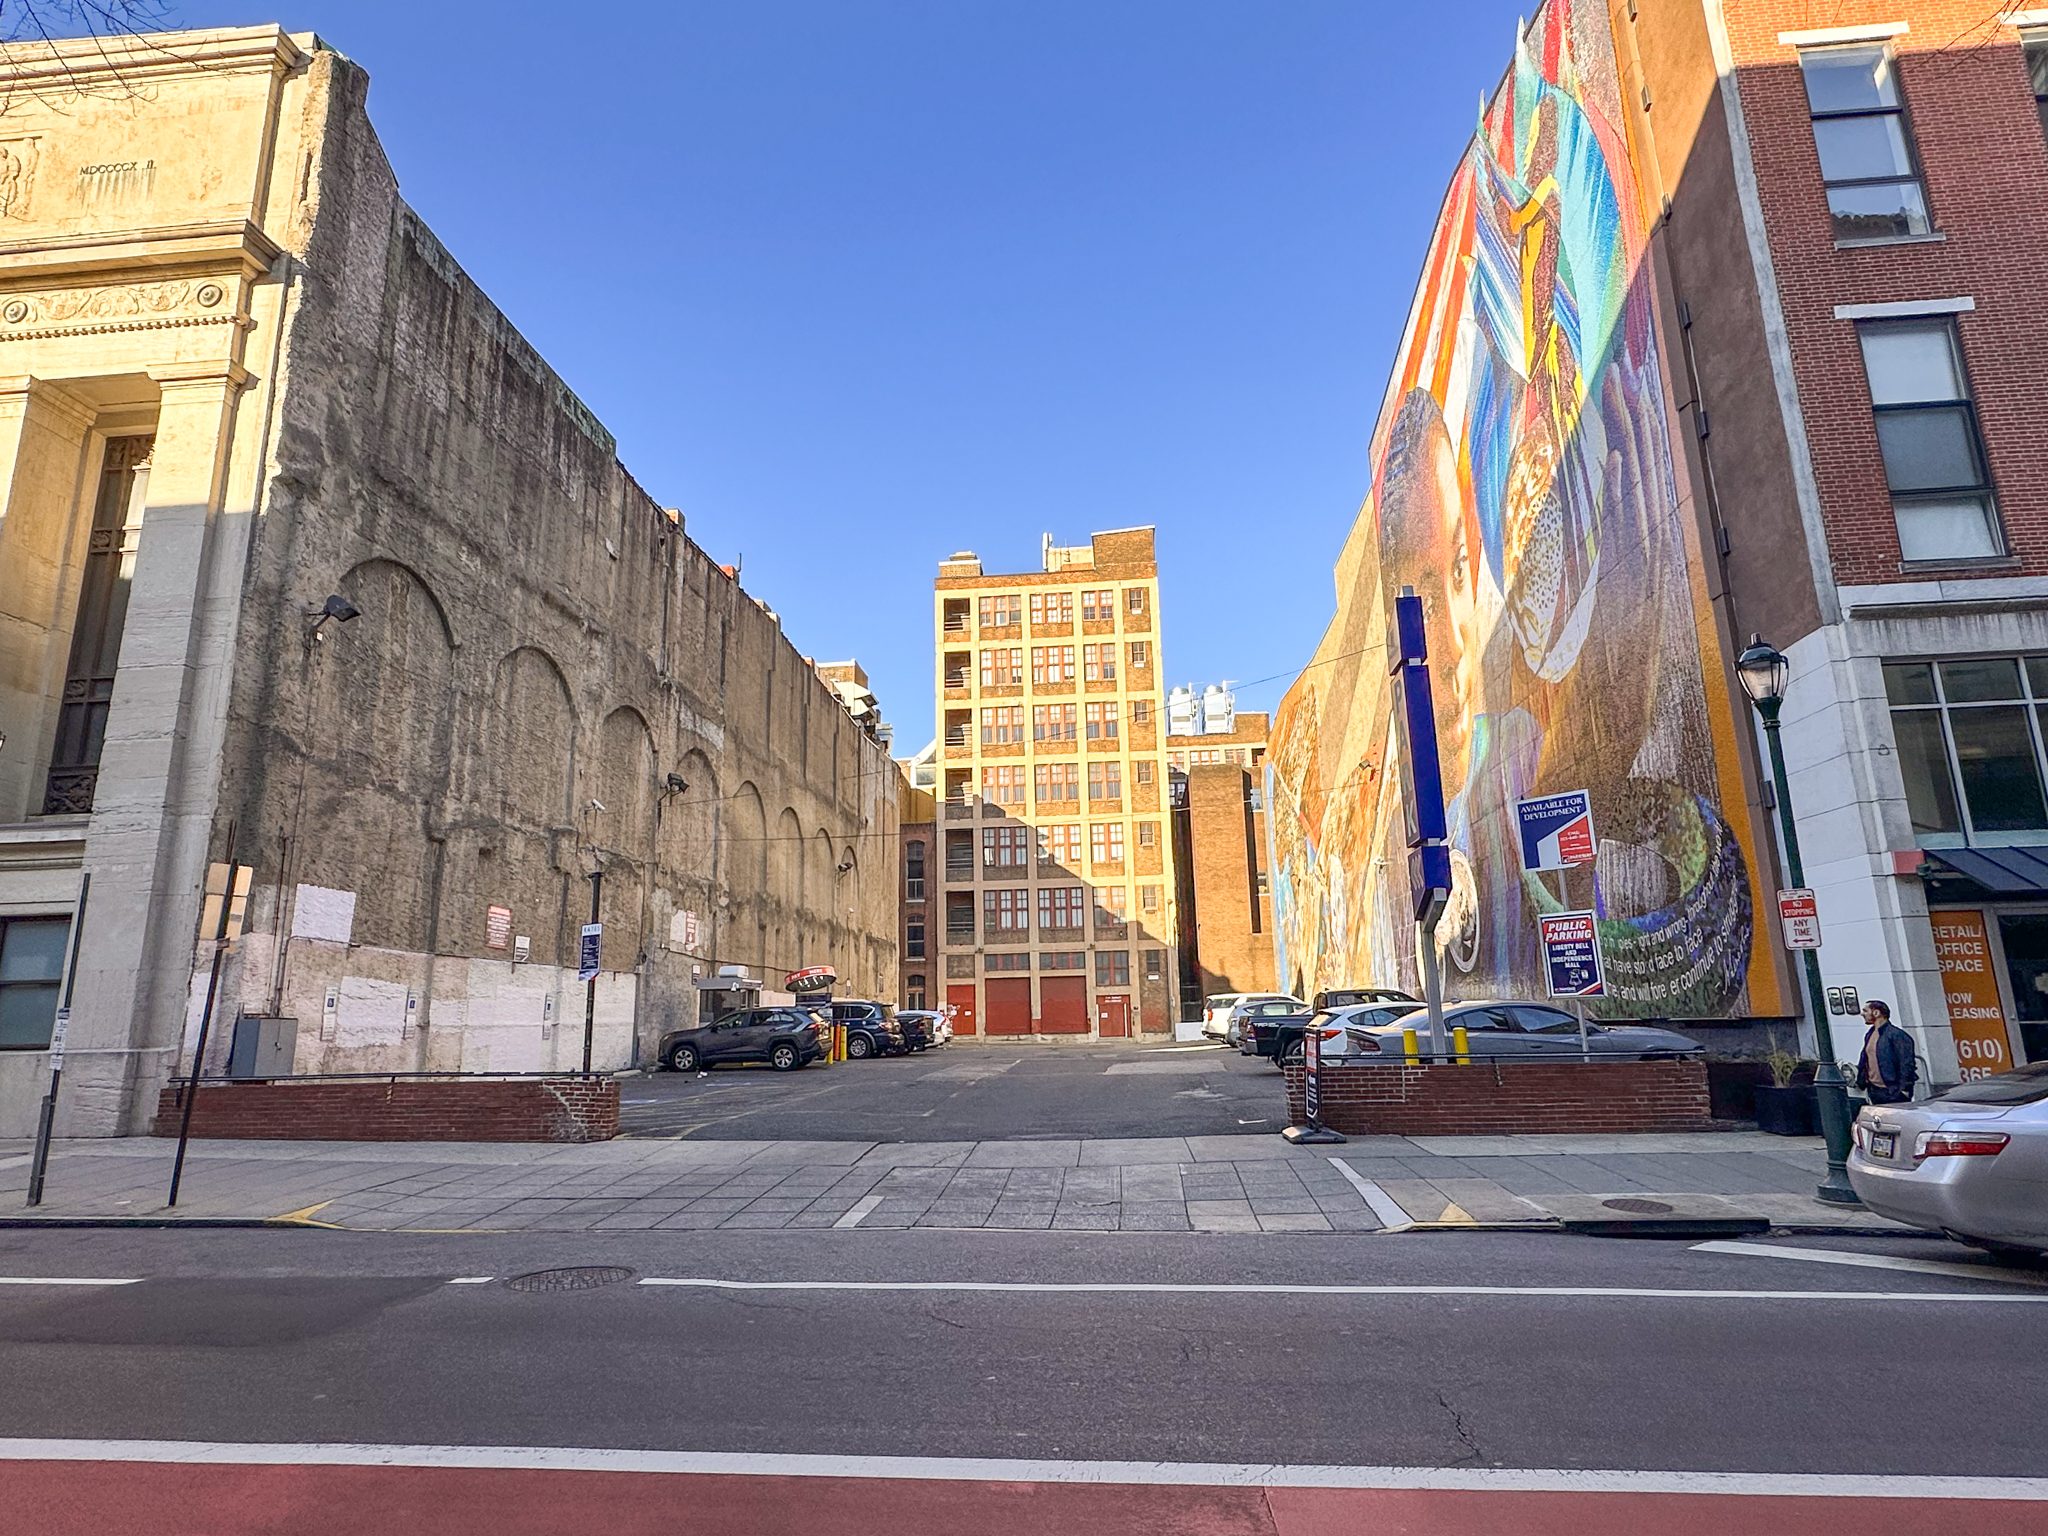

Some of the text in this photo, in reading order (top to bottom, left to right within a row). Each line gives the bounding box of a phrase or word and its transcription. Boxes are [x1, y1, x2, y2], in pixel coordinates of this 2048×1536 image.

[1394, 679, 1417, 837] PARK
[1521, 797, 1583, 813] AVAILABLE FOR
[1524, 806, 1581, 820] DEVELOPMENT
[1784, 908, 1815, 917] STOPPING
[1548, 921, 1586, 932] PUBLIC
[1794, 919, 1808, 927] ANY
[1545, 930, 1592, 942] PARKING
[1651, 926, 1665, 946] and
[1793, 928, 1812, 936] TIME
[1932, 925, 1982, 938] RETAIL/
[1552, 943, 1574, 951] LIBERTY
[1612, 955, 1632, 975] have
[1633, 956, 1654, 975] stod
[1655, 951, 1674, 970] face
[1674, 944, 1684, 961] to
[1685, 928, 1703, 955] face
[1935, 942, 1983, 955] OFFICE
[1551, 955, 1593, 963] INDEPENDENCE
[1620, 983, 1637, 1001] and
[1650, 977, 1680, 1000] foreer
[1681, 946, 1715, 990] continue
[1714, 935, 1723, 956] to
[1939, 959, 1984, 973] SPACE
[1955, 1038, 2003, 1063] (610)
